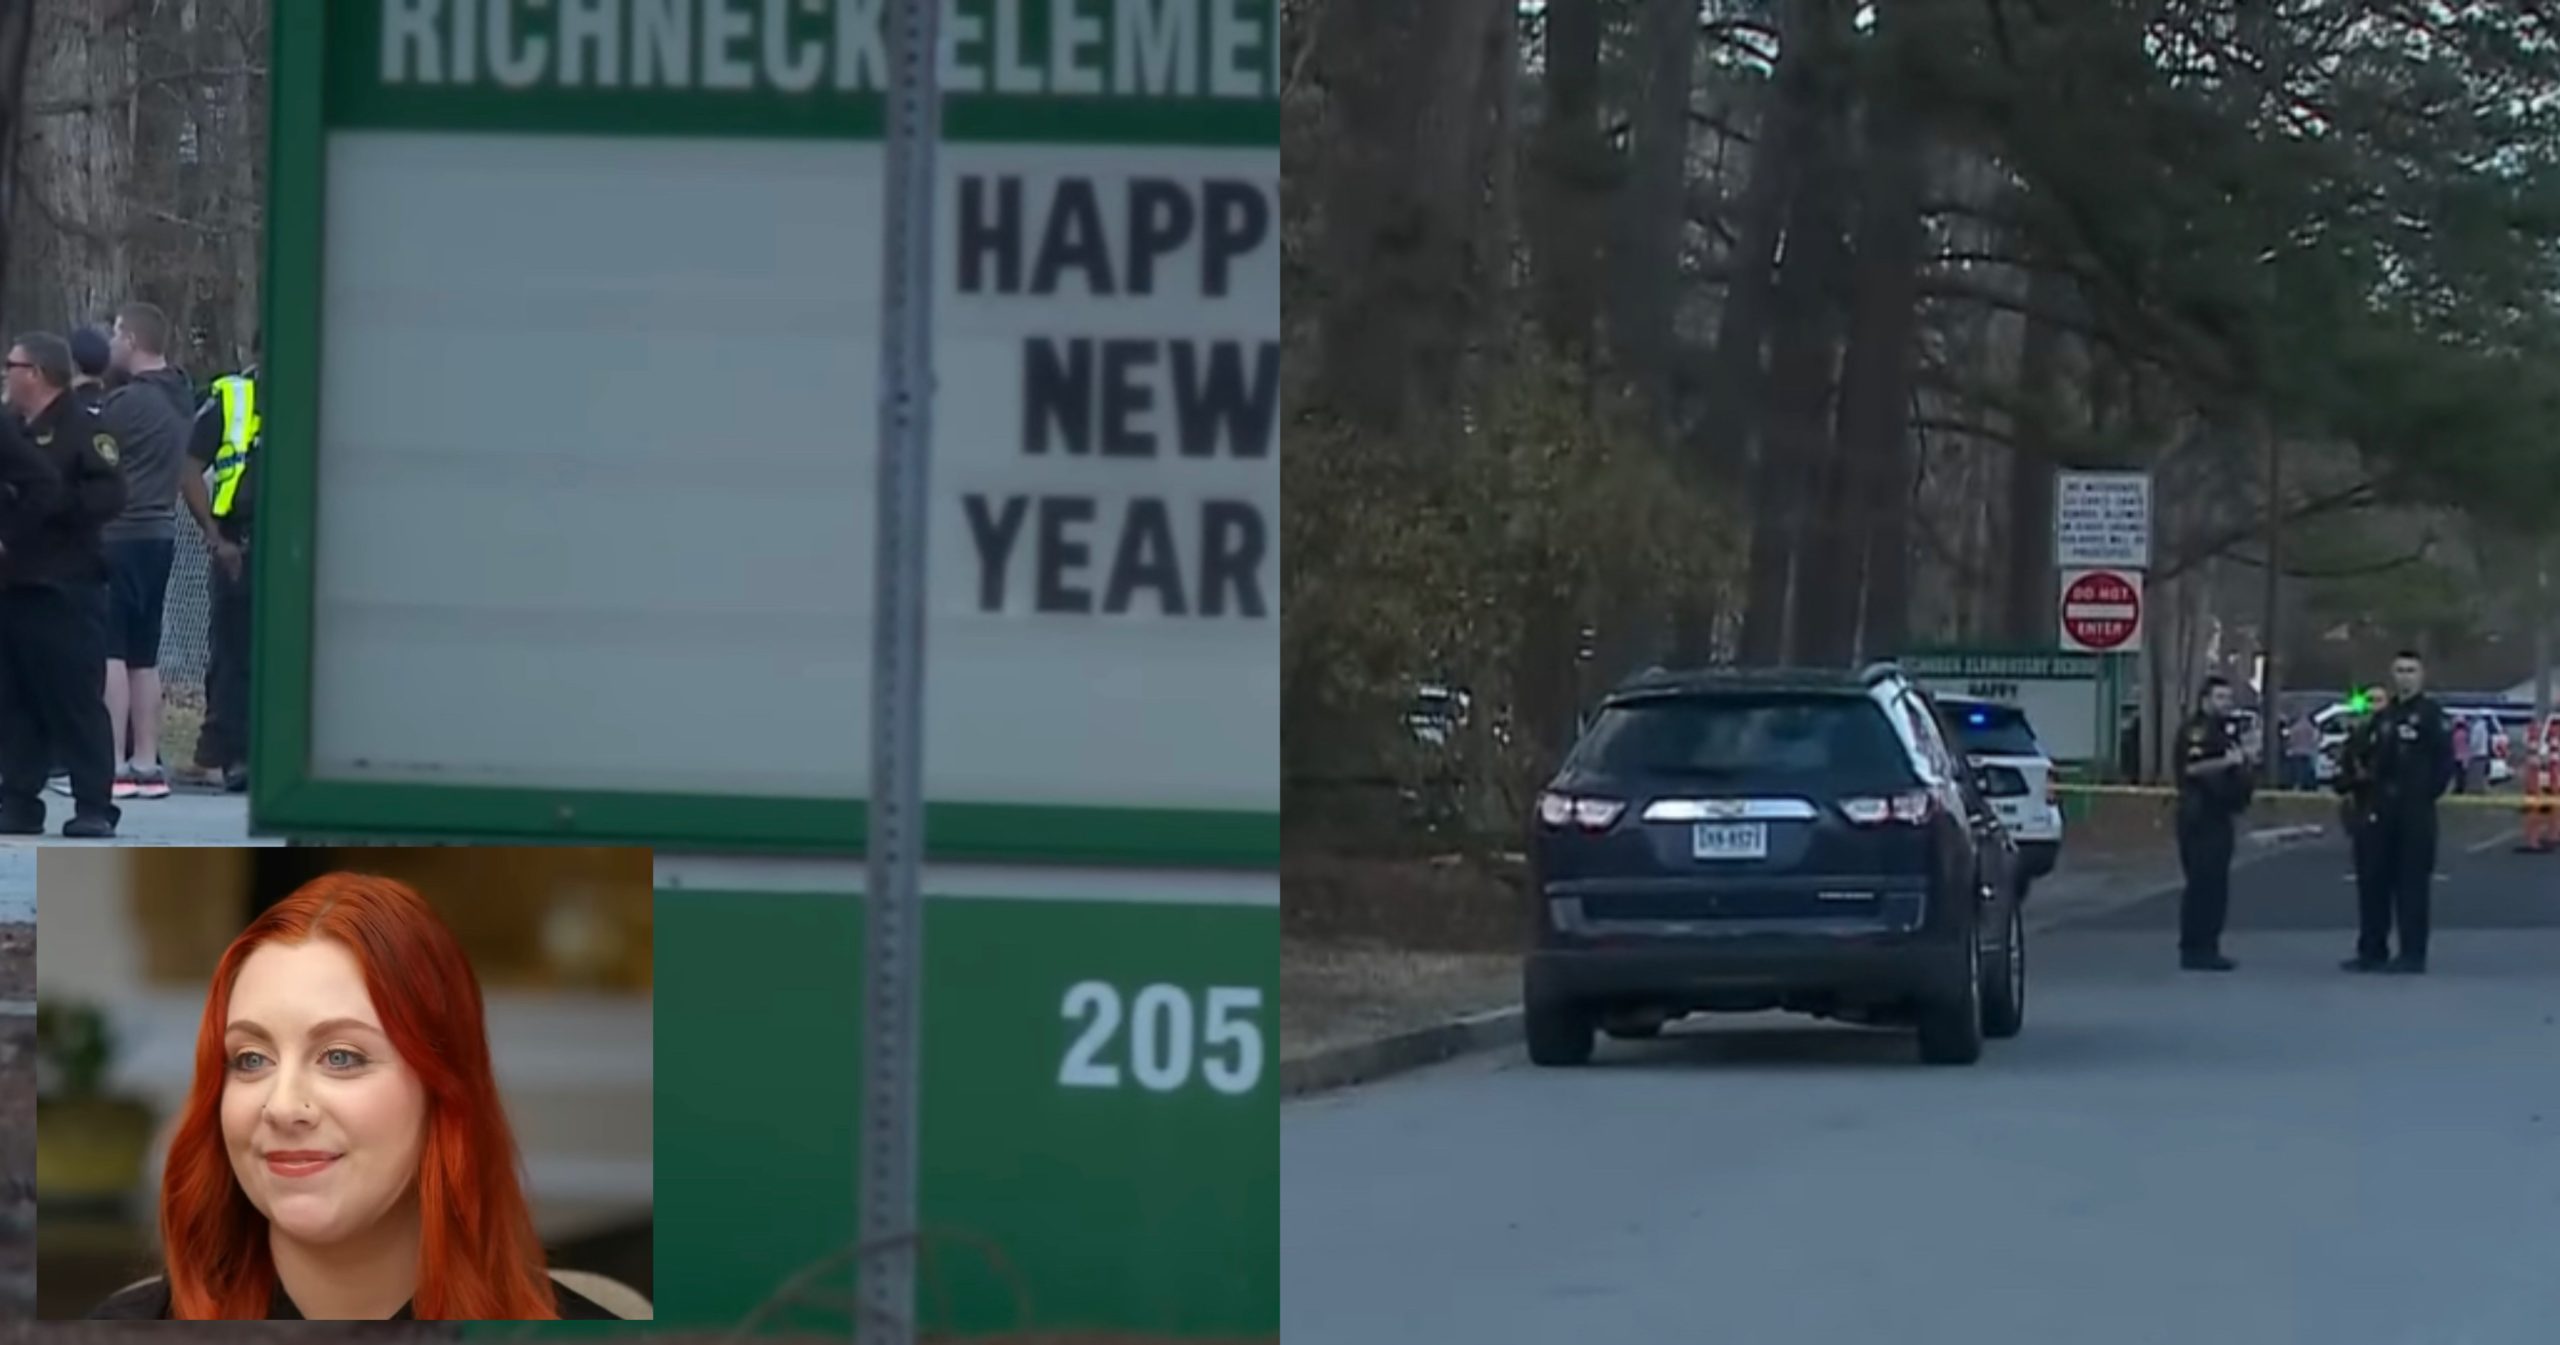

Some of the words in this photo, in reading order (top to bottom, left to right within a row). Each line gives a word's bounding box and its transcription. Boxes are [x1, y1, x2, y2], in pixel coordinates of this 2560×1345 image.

[381, 0, 890, 91] RICHNECK
[938, 0, 1279, 96] ELEME
[957, 176, 1279, 297] HAPP
[1022, 337, 1279, 458] NEW
[962, 494, 1268, 617] YEAR
[2073, 587, 2095, 600] DO
[2099, 587, 2128, 600] NOT
[2078, 622, 2122, 636] ENTER
[1058, 979, 1264, 1094] 205
